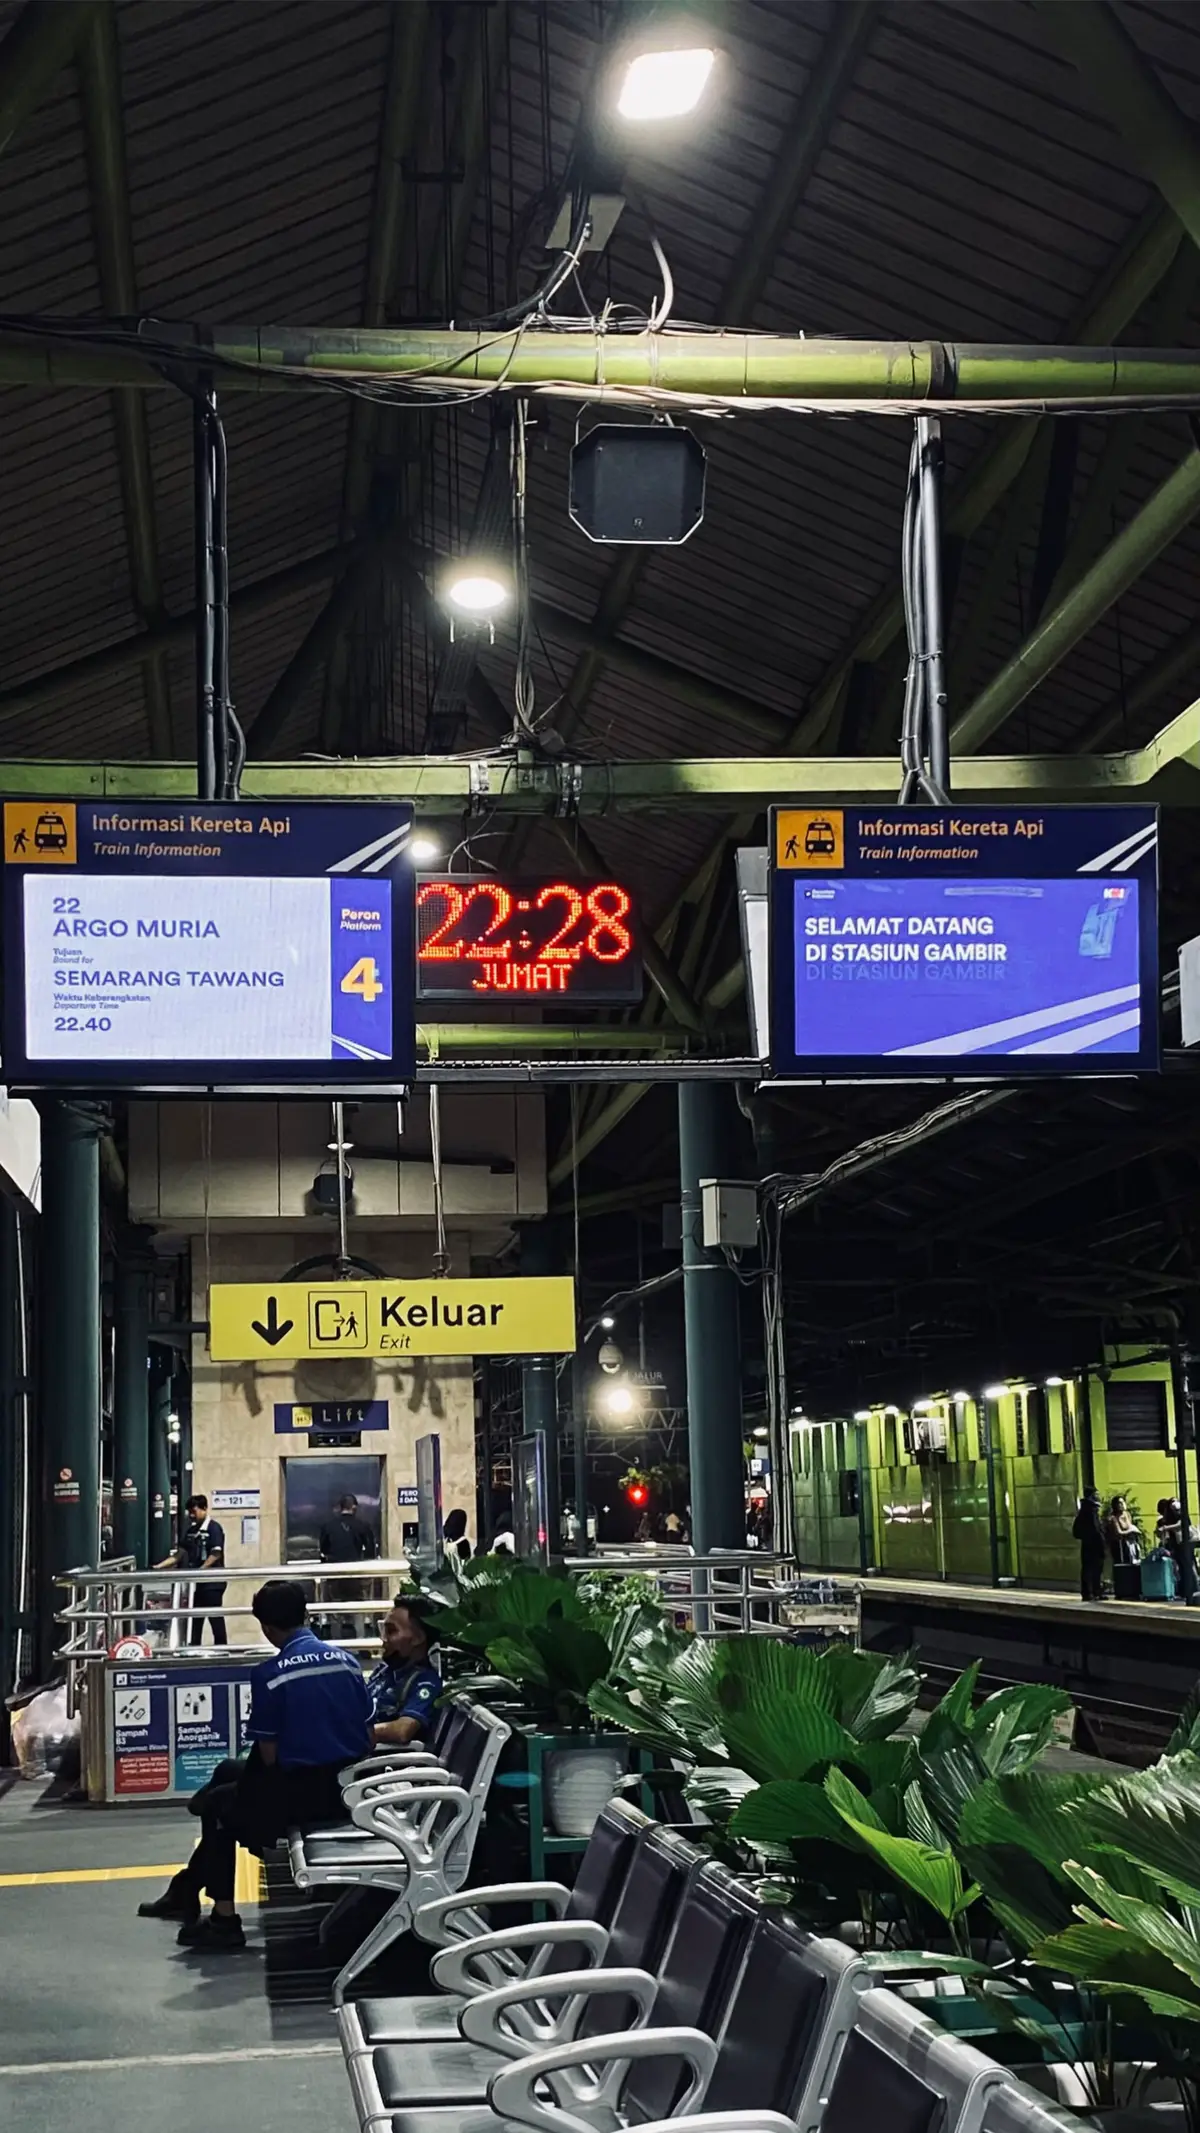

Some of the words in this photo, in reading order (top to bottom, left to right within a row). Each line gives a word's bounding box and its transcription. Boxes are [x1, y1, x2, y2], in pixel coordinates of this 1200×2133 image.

[92, 814, 184, 832] Informasi
[191, 816, 253, 833] Kereta
[259, 817, 291, 837] Api
[858, 819, 944, 836] Informasi
[950, 820, 1009, 836] Kereta
[1013, 819, 1044, 839] Api
[93, 842, 130, 855] Train
[134, 843, 221, 858] Information
[859, 847, 893, 859] Train
[897, 846, 979, 861] Information
[53, 897, 81, 914] 22
[341, 908, 380, 921] Peron
[417, 884, 630, 960] 22:28
[53, 919, 128, 937] ARGO
[137, 920, 220, 938] MURIA
[340, 921, 381, 932] Platform
[804, 917, 903, 935] SELAMAT
[907, 917, 994, 935] DATANG
[53, 948, 83, 957] Tujuan
[805, 943, 827, 962] DI
[831, 943, 919, 962] STASIUN
[923, 943, 1007, 962] GAMBIR
[54, 970, 180, 986] SEMARANG
[187, 971, 284, 987] TAWANG
[340, 957, 383, 1002] 4
[471, 962, 573, 991] JUMAT
[54, 1017, 112, 1032] 22.40
[380, 1295, 504, 1328] Keluar
[379, 1334, 411, 1350] Exit
[322, 1408, 365, 1423] Lift
[229, 1497, 243, 1505] 121
[277, 1653, 320, 1669] FACILITY
